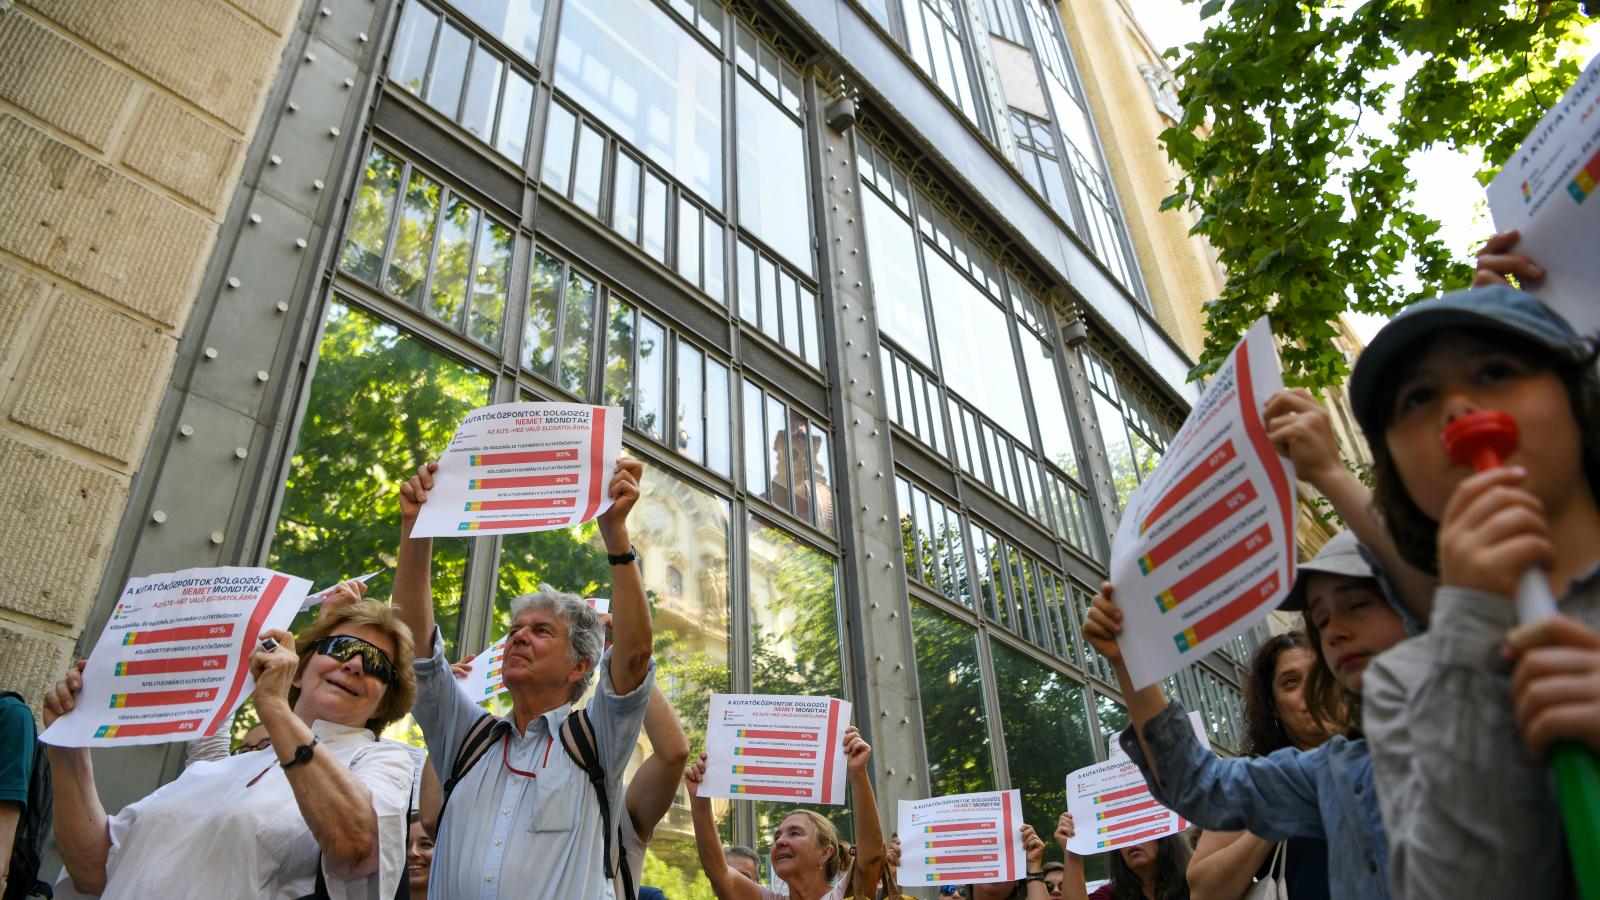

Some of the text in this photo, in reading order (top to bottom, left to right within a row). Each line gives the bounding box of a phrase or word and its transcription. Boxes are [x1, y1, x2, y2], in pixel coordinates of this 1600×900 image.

[464, 410, 540, 424] KUTATÓKÖZPONTOK
[135, 578, 213, 595] KUTATÓKÖZPONTOK
[214, 576, 266, 585] DOLGOZÓI
[182, 586, 212, 596] NEMET
[189, 596, 205, 604] VALÓ
